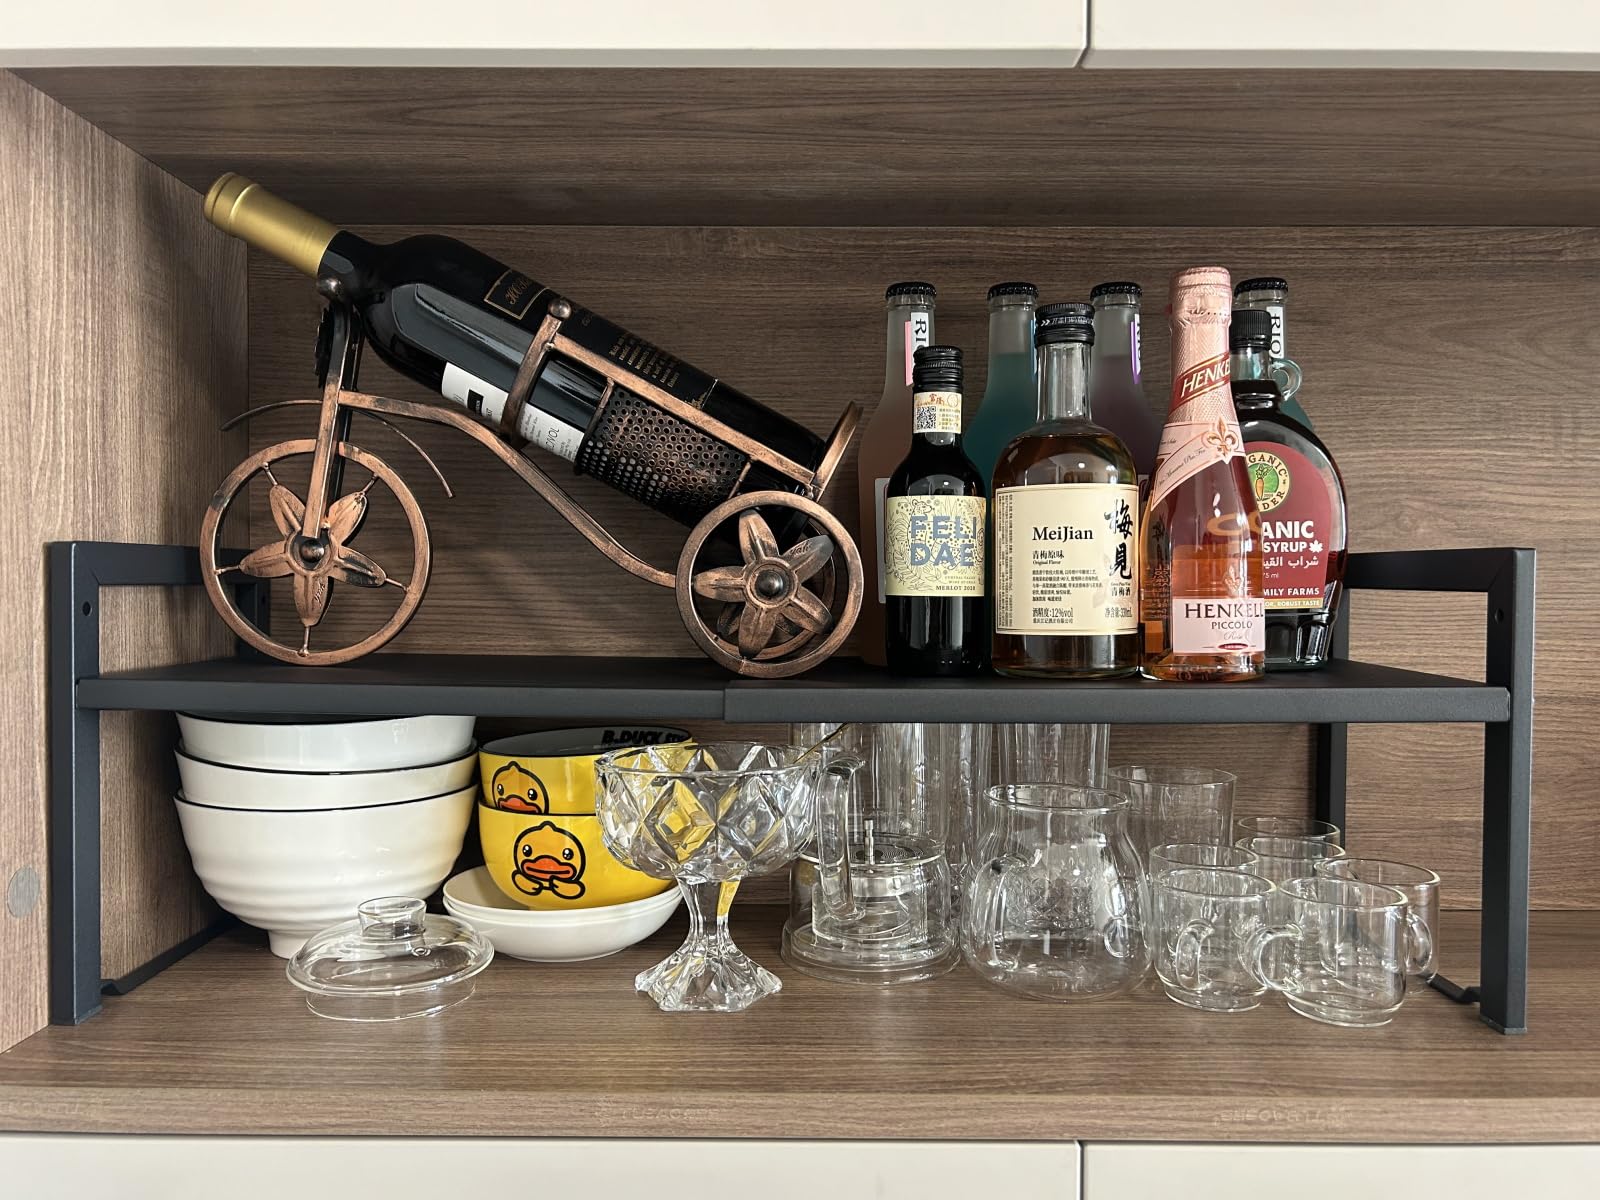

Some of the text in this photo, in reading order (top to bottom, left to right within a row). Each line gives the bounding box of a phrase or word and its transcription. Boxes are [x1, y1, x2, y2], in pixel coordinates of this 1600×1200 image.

[915, 318, 927, 347] RI
[1270, 313, 1281, 355] RIO
[911, 515, 976, 539] FELI
[1032, 526, 1093, 543] MeiJian
[911, 542, 975, 566] DAE
[1263, 541, 1308, 553] SYRUP
[1032, 550, 1065, 559] 青梅原味
[1288, 555, 1319, 568] شراب
[1111, 587, 1131, 596] 青梅酒
[1287, 588, 1320, 596] FARMS
[1185, 603, 1263, 618] HENKELL
[1211, 621, 1253, 630] PICCOLO
